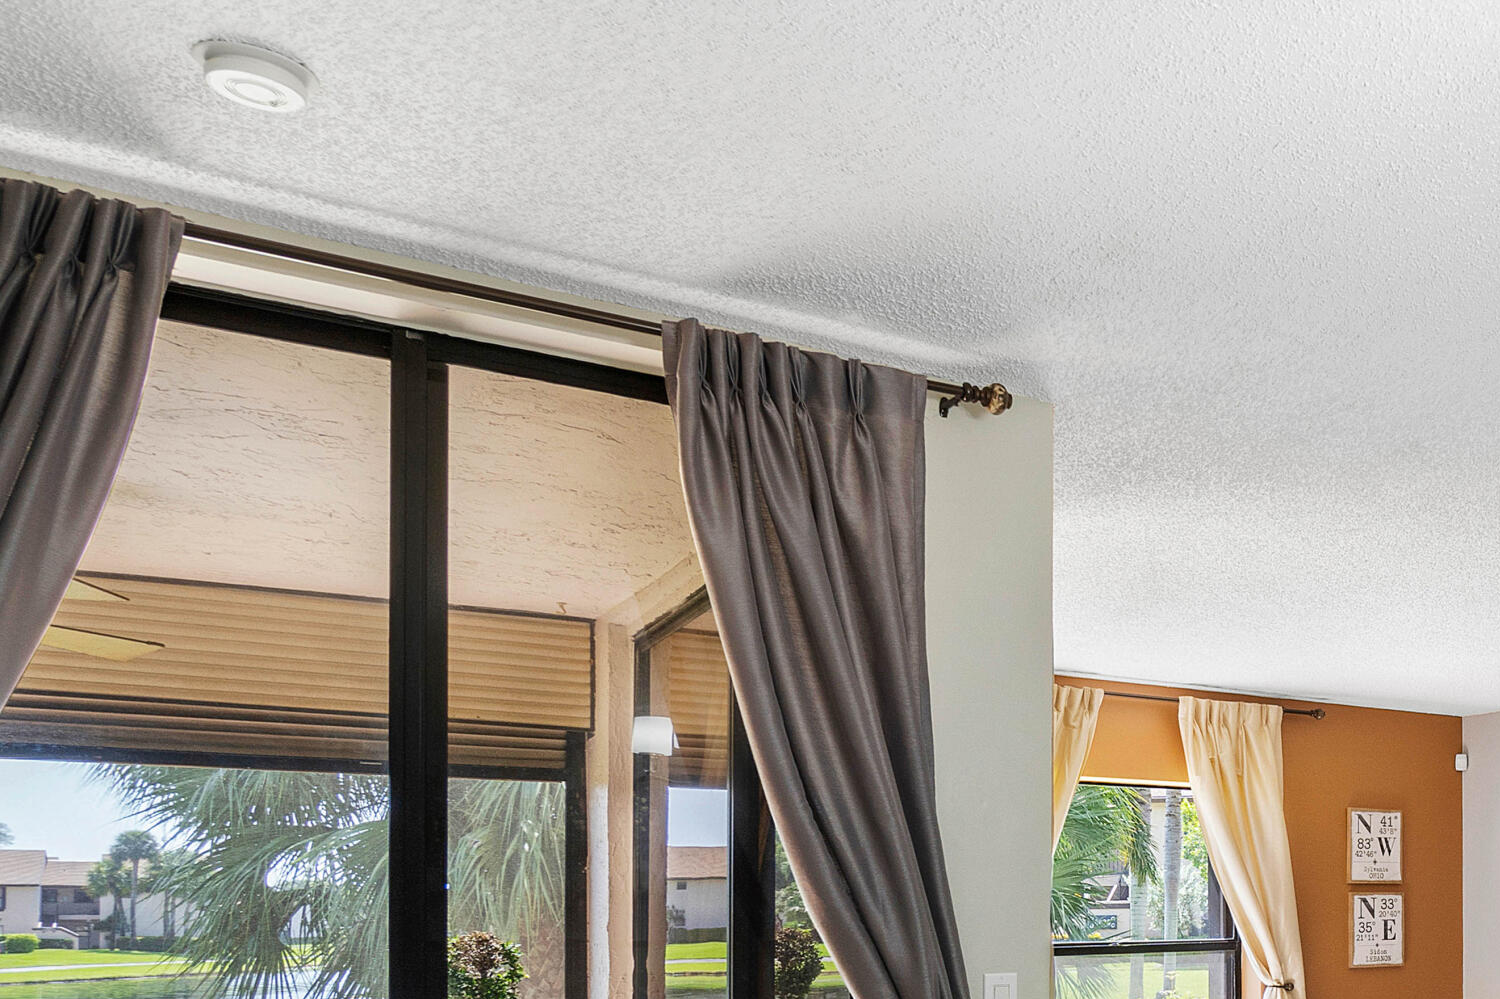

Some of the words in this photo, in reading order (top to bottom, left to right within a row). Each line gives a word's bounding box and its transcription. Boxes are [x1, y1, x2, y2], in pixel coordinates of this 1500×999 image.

[1354, 814, 1372, 834] N
[1376, 837, 1397, 857] W
[1358, 897, 1377, 919] N
[1382, 919, 1397, 941] E
